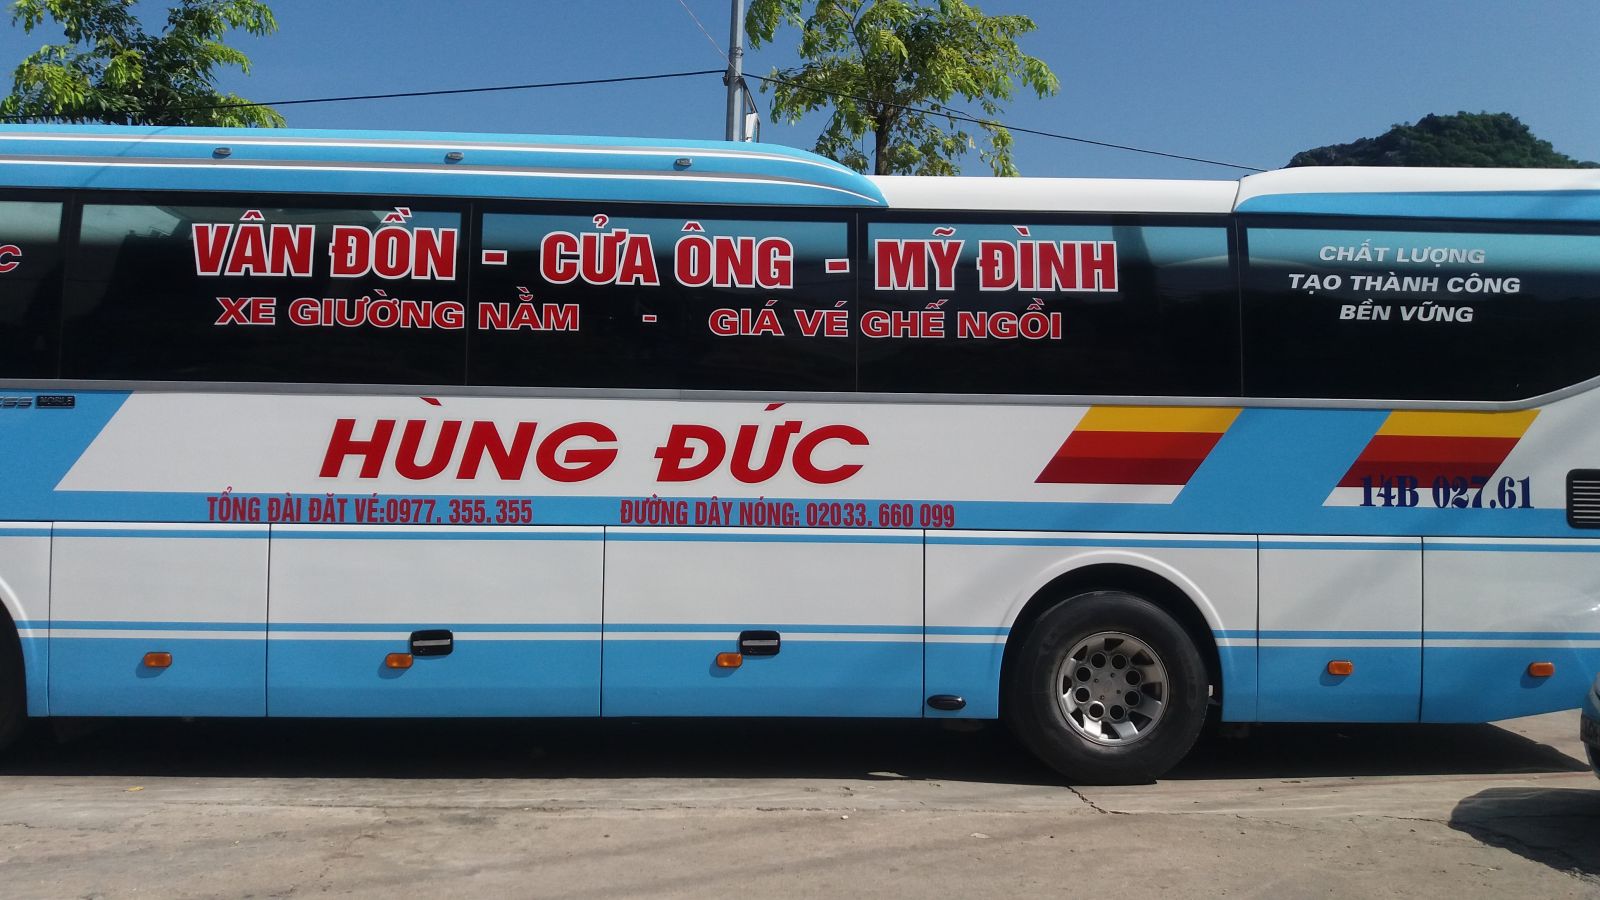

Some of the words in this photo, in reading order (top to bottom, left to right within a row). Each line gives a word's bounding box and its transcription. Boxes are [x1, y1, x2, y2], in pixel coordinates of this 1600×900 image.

[192, 210, 315, 277] VÂN
[329, 207, 458, 280] ĐỒN
[540, 214, 660, 287] CỬA
[674, 221, 794, 289] ÔNG
[875, 227, 965, 291] MỸ
[977, 225, 1119, 293] ĐÌNH
[1319, 239, 1390, 262] CHẤT
[1396, 246, 1486, 267] LƯỢNG
[1288, 273, 1342, 294] TẠO
[1350, 271, 1438, 292] THÀNH
[1446, 272, 1521, 293] CÔNG
[214, 296, 276, 325] XE
[288, 289, 465, 330] GIƯỜNG
[478, 286, 580, 331] NẰM
[709, 299, 784, 337] GIÁ
[795, 300, 849, 337] VÉ
[860, 299, 946, 338] GHẾ
[957, 297, 1063, 340] NGỒI
[1339, 298, 1391, 321] BỀN
[1400, 301, 1474, 323] VỮNG
[319, 397, 618, 484] HÙNG
[655, 402, 870, 485] ĐỨC
[207, 486, 260, 522] TỔNG
[267, 492, 301, 523] ĐÀI
[1359, 475, 1420, 508] 14B
[1432, 475, 1535, 509] 027.61
[620, 493, 688, 525] ĐƯỜNG
[695, 496, 732, 525] DÂY
[739, 496, 800, 527] NÓNG:
[806, 502, 872, 527] 02033.
[878, 503, 914, 528] 660
[920, 503, 955, 528] 099
